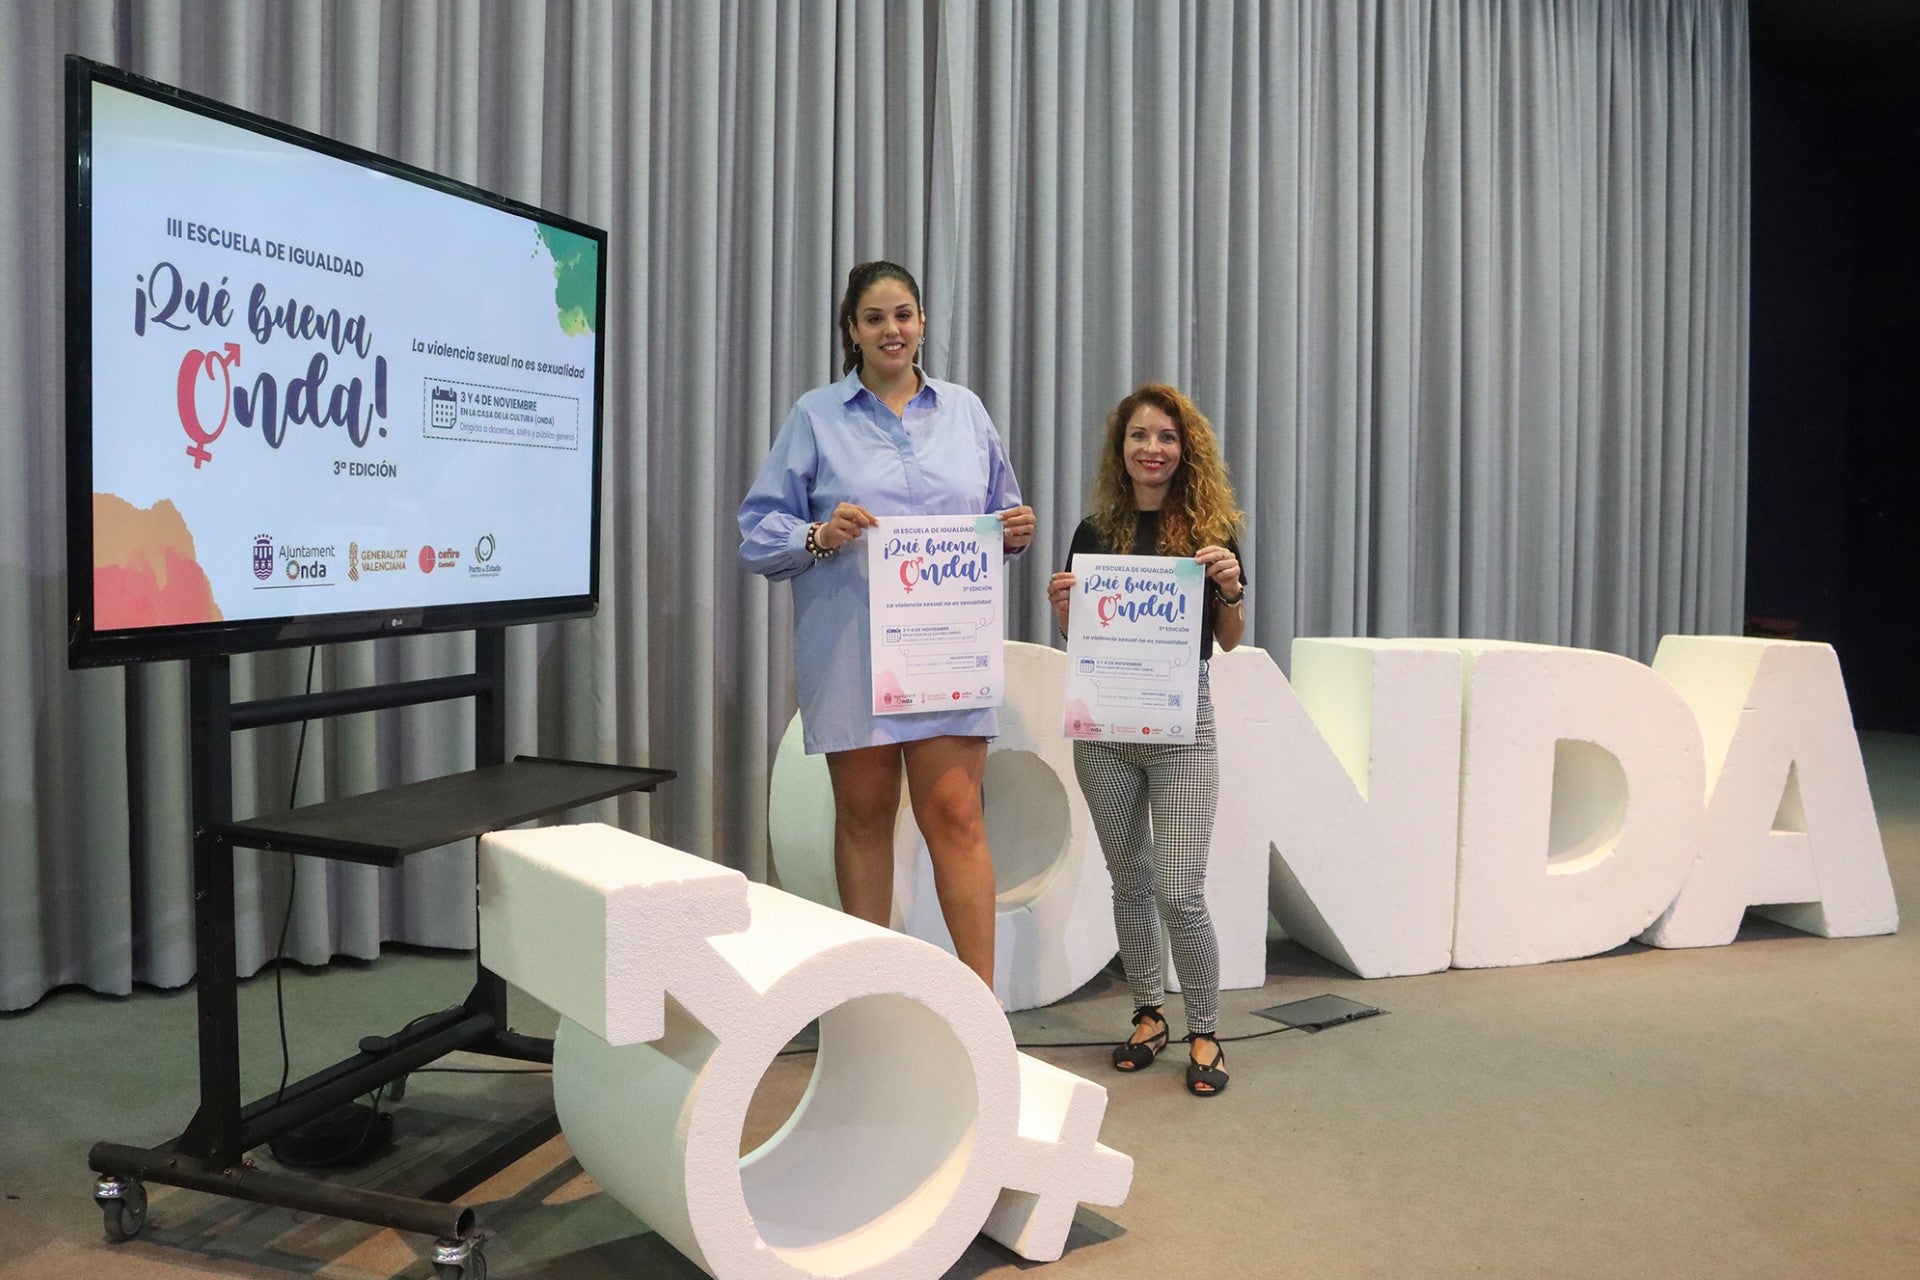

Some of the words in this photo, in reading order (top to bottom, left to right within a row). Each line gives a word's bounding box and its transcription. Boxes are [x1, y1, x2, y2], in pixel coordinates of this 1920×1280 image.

[167, 217, 182, 238] III
[187, 222, 261, 256] ESCUELA
[266, 240, 285, 261] DE
[289, 246, 364, 278] IGUALDAD
[134, 261, 234, 337] ¡Qué
[248, 282, 372, 360] buena
[412, 338, 424, 352] La
[427, 341, 475, 361] violencia
[477, 352, 509, 366] sexual
[511, 358, 523, 369] no
[525, 361, 535, 370] es
[537, 362, 585, 379] sexualidad
[177, 342, 387, 469] Onda!
[460, 391, 466, 403] 3
[468, 392, 473, 403] Y
[475, 393, 480, 405] 4
[481, 394, 492, 406] DE
[493, 396, 537, 412] NOVIEMBRE
[460, 407, 468, 416] EN
[469, 408, 476, 417] LA
[477, 409, 493, 418] CASA
[494, 411, 501, 419] DE
[502, 412, 509, 420] LA
[509, 412, 534, 423] CULTURA
[534, 415, 555, 426] (ONDA)
[460, 422, 482, 434] Dirigido
[333, 461, 347, 475] 3ª
[350, 460, 397, 478] EDICIÓN
[279, 545, 335, 561] Ajuntament
[361, 550, 408, 560] GENERALITAT
[884, 538, 920, 560] ¡Qué
[925, 538, 979, 556] buena
[286, 560, 326, 580] Onda
[361, 562, 407, 572] VALENCIANA
[900, 552, 987, 593] Onda!
[1084, 573, 1119, 594] ¡Qué
[1125, 576, 1178, 596] buena
[1097, 593, 1186, 628] Onda!
